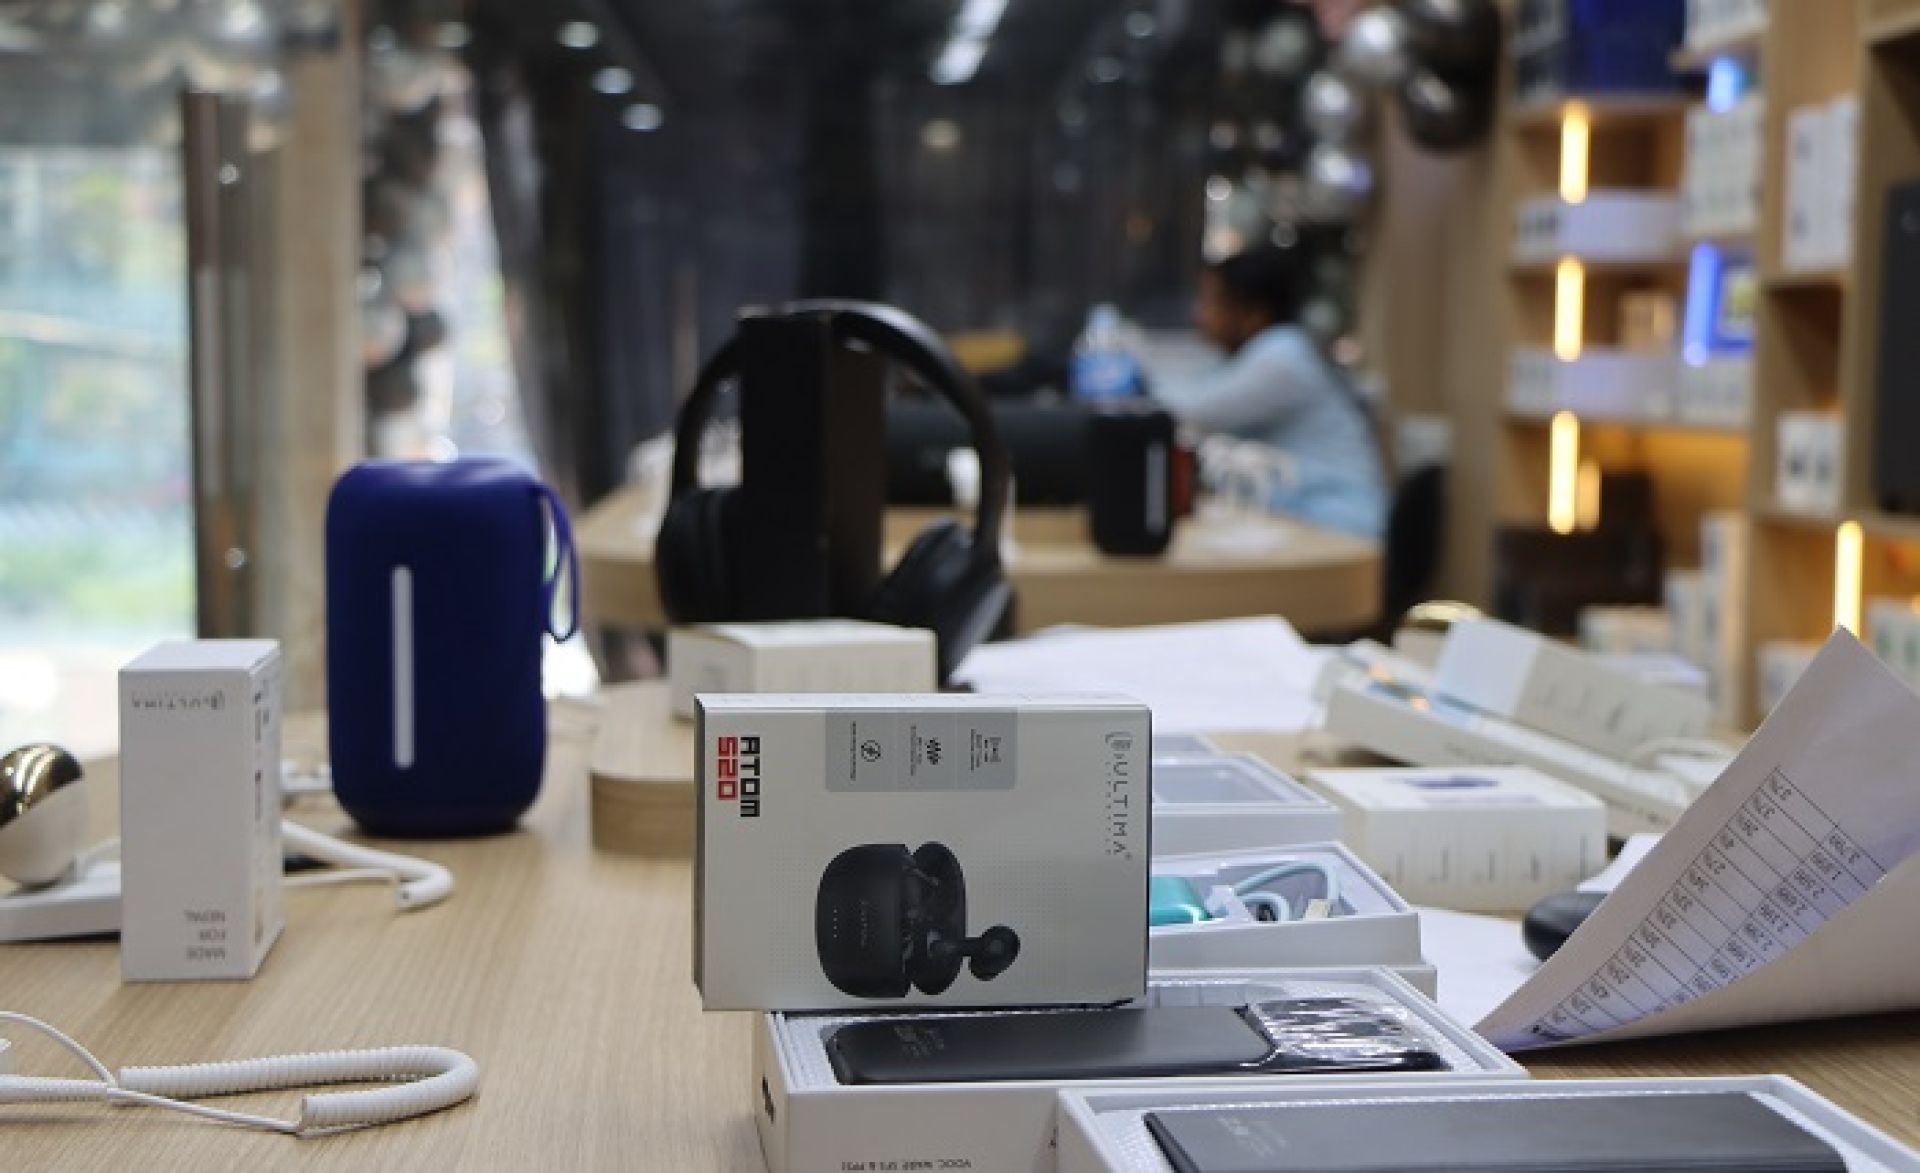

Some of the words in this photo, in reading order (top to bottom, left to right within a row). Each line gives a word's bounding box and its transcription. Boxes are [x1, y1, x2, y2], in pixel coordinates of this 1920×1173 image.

[718, 736, 739, 801] S20
[740, 736, 761, 818] ATOM
[1112, 761, 1128, 855] ULTIMA
